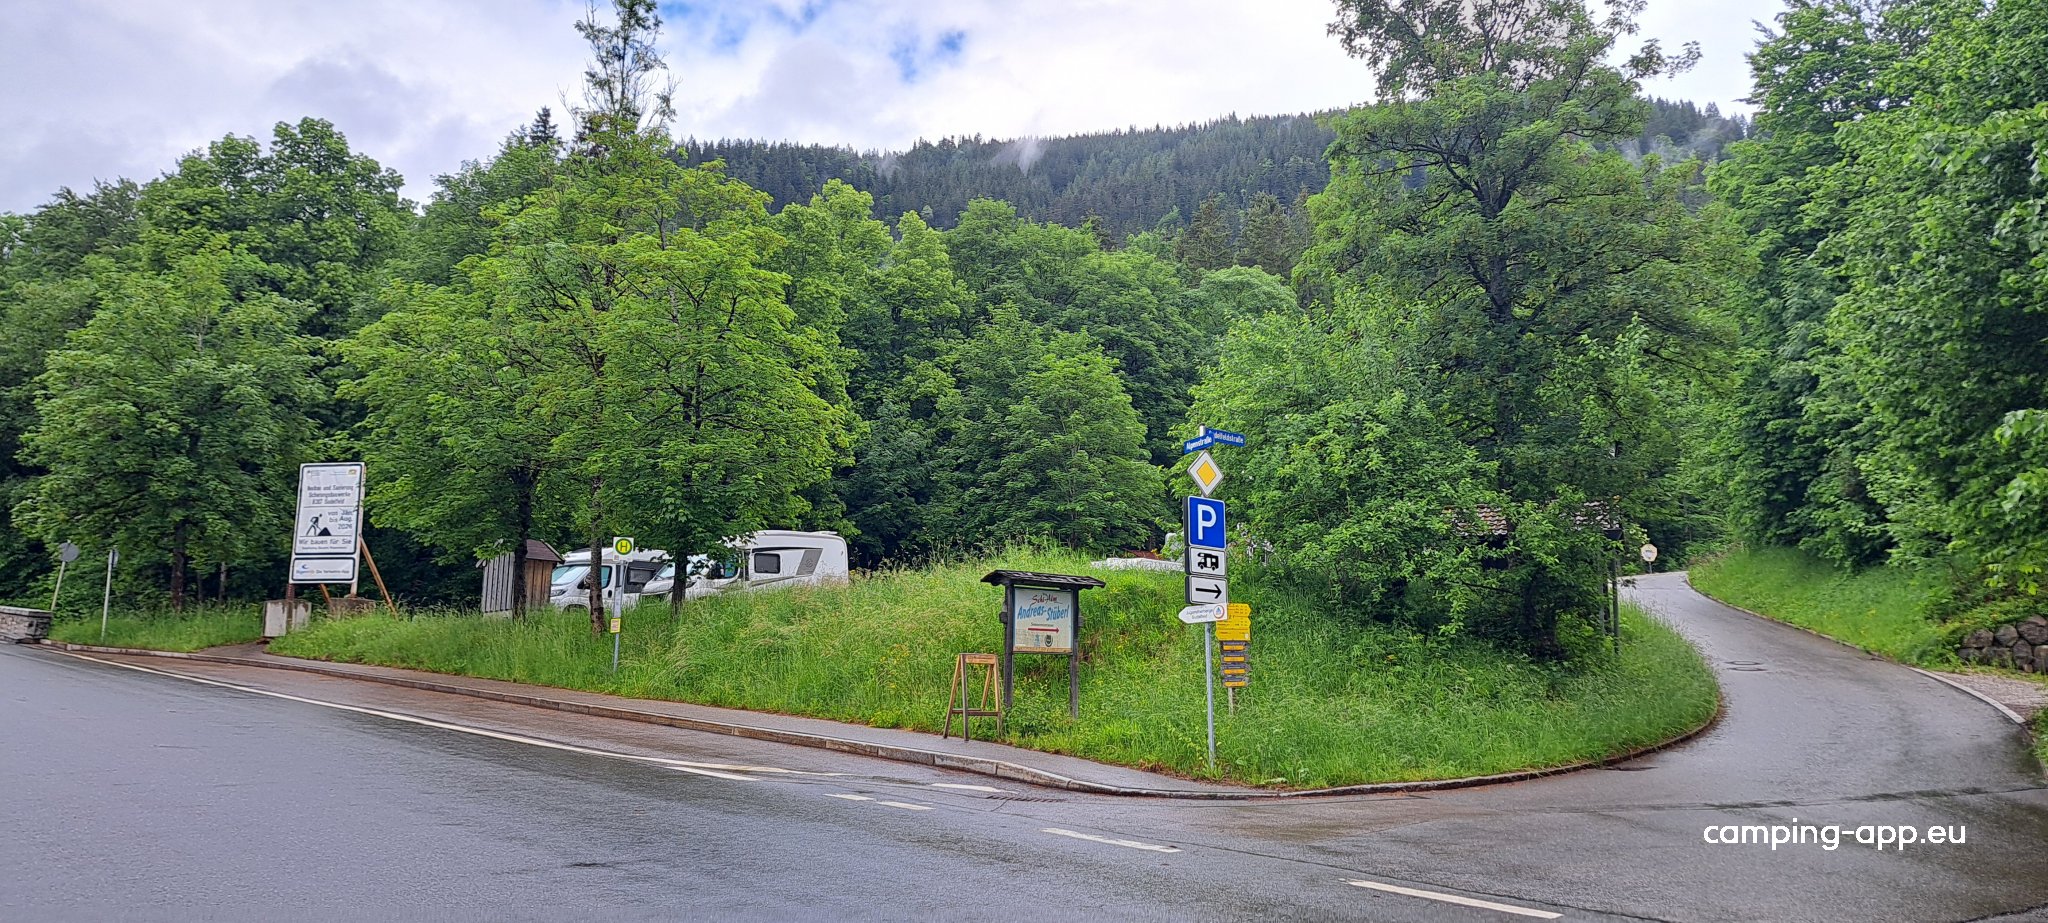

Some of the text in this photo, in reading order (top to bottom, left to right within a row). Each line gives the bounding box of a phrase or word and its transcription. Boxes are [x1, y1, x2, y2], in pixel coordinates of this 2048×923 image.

[1186, 435, 1212, 450] Alpenstraße
[1197, 504, 1217, 540] P
[620, 542, 628, 551] H
[1017, 604, 1070, 621] Andreas-Stüberl
